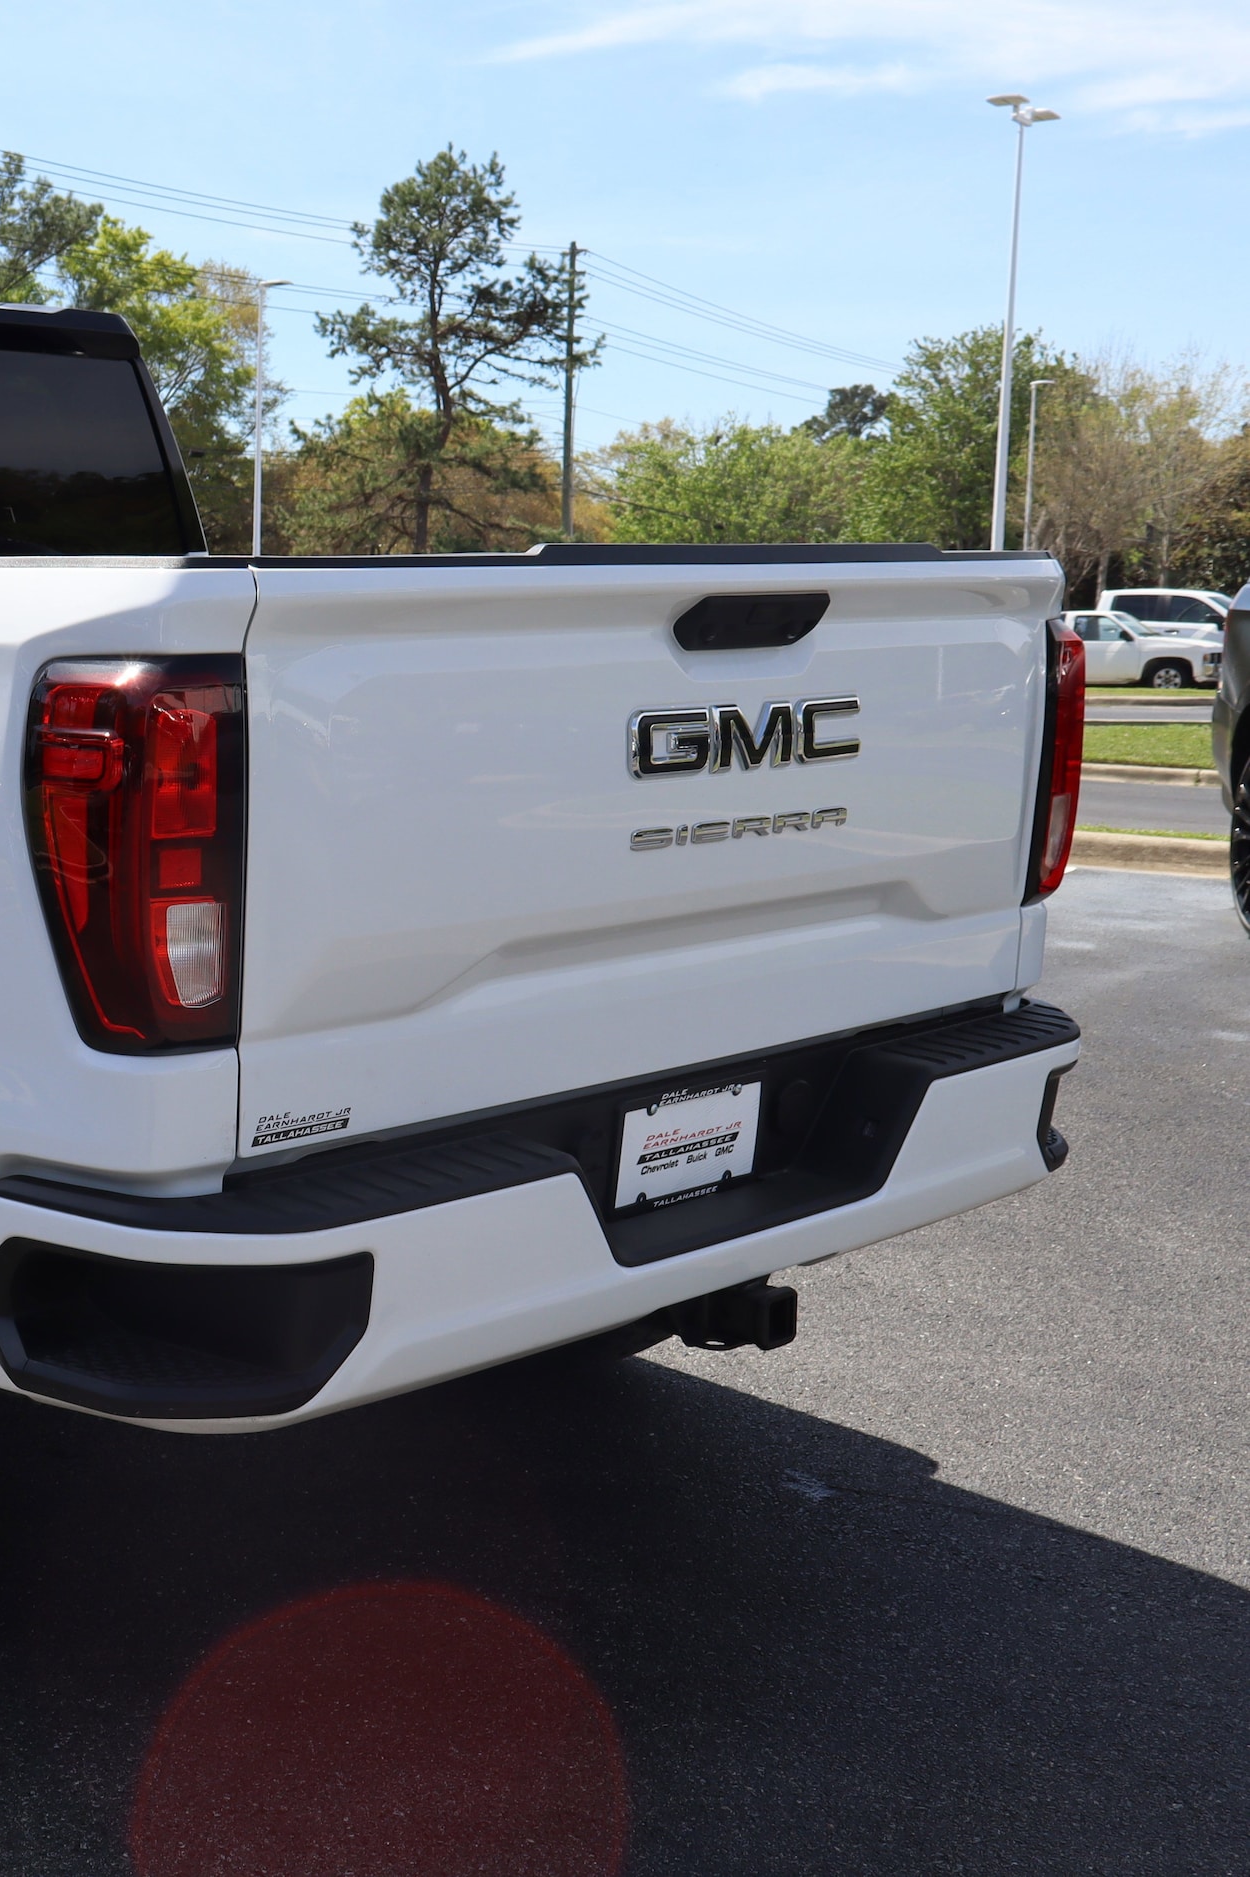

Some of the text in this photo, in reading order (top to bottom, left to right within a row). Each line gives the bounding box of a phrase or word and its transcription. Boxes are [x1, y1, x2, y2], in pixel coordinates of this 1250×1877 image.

[629, 695, 861, 779] GMC
[630, 807, 848, 851] SIERRA
[659, 1084, 735, 1106] EARNHARDT JR
[661, 1088, 688, 1100] DALE
[256, 1107, 351, 1132] EARNHARDT JR
[258, 1111, 291, 1124] DALE
[257, 1120, 344, 1145] TALLAHASSEE
[643, 1121, 742, 1150] EARNHARDT JR
[646, 1128, 681, 1142] DALE
[640, 1144, 735, 1176] Chevrolet Buick GMC
[644, 1134, 733, 1162] TALLAHASSEE
[653, 1185, 718, 1208] TALLAHASSEE
